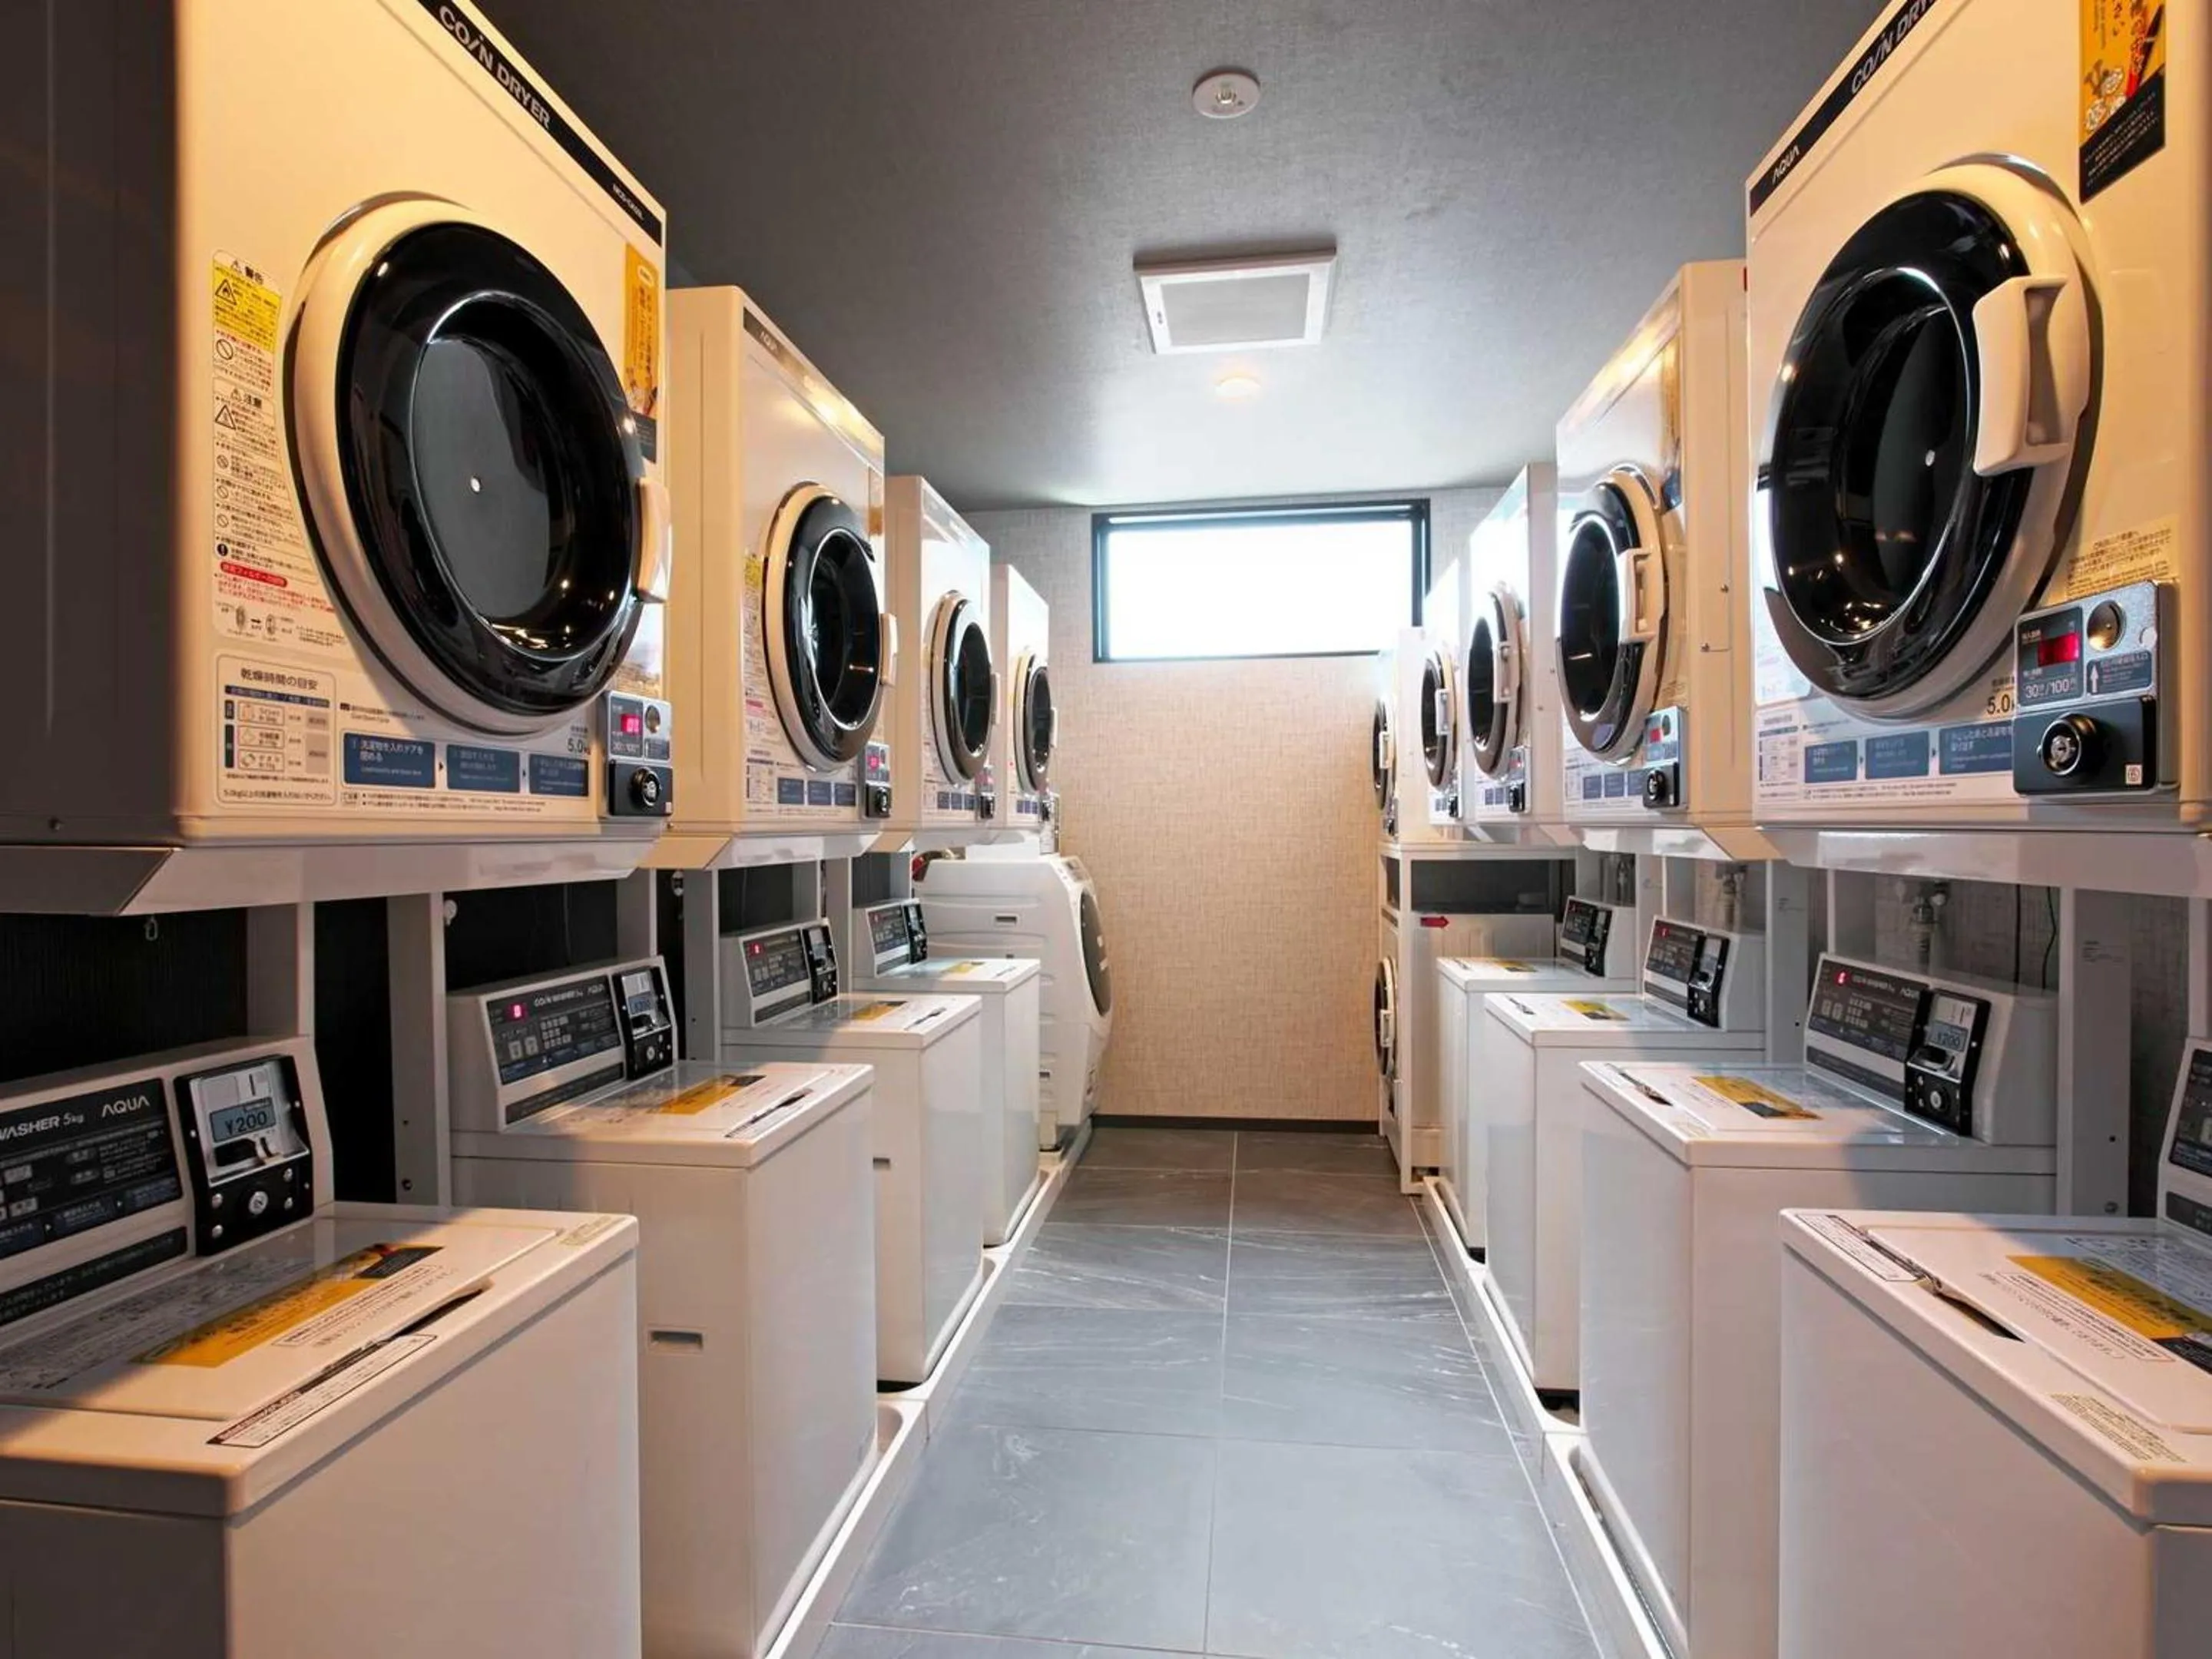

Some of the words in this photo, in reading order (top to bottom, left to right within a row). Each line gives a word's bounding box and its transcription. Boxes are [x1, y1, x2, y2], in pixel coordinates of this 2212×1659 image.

[439, 5, 494, 71] COIN
[497, 62, 550, 130] DRYER
[1772, 144, 1800, 185] AQUA
[101, 1094, 151, 1118] AQUA
